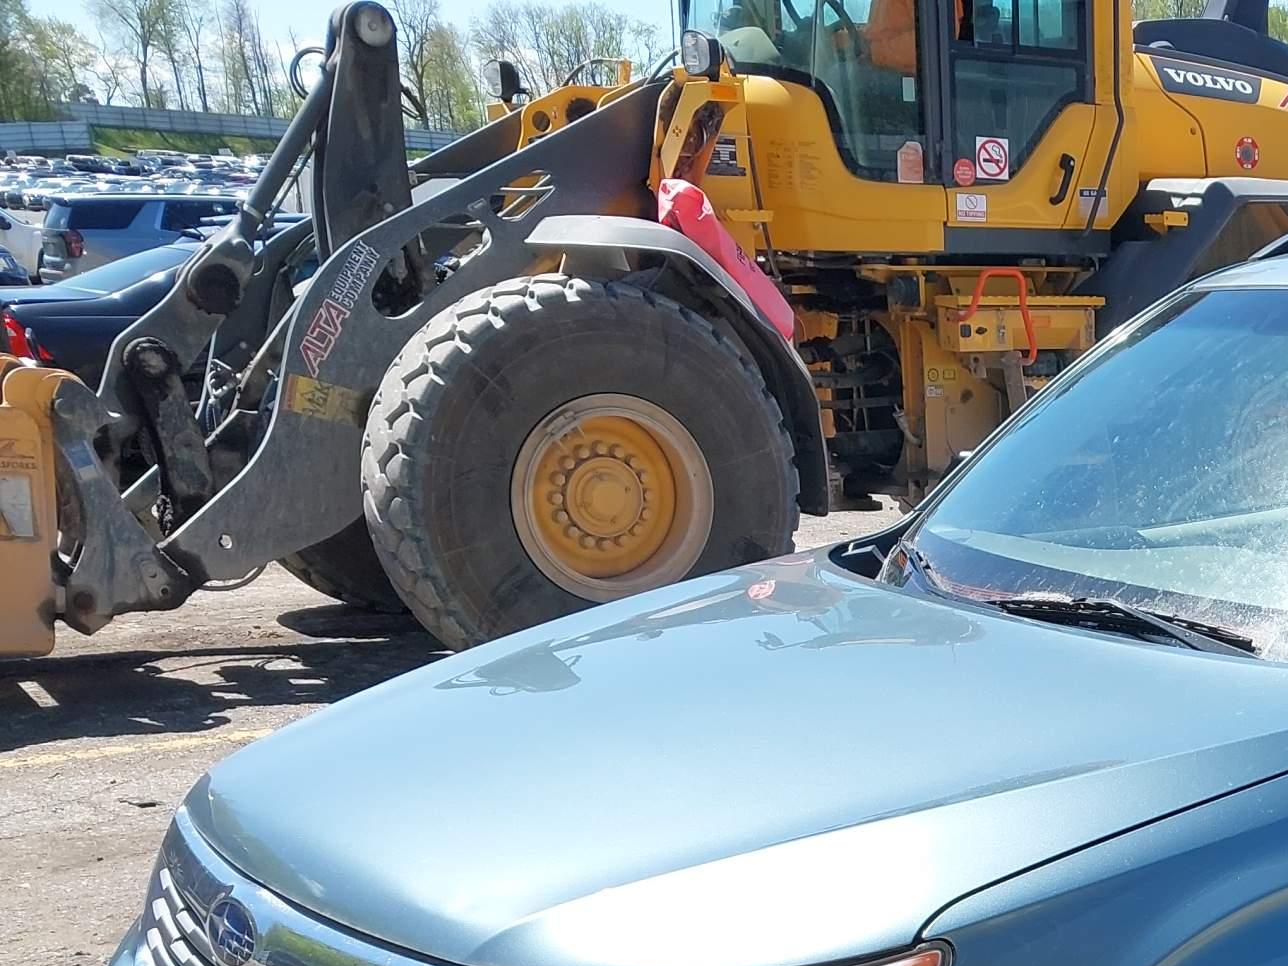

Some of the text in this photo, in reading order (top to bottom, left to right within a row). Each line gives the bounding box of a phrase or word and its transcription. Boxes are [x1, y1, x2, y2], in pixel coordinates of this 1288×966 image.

[1163, 67, 1253, 95] VOLVO
[330, 239, 370, 301] EQUIPMENT
[342, 246, 380, 310] COMPANY
[300, 298, 351, 378] ALTA
